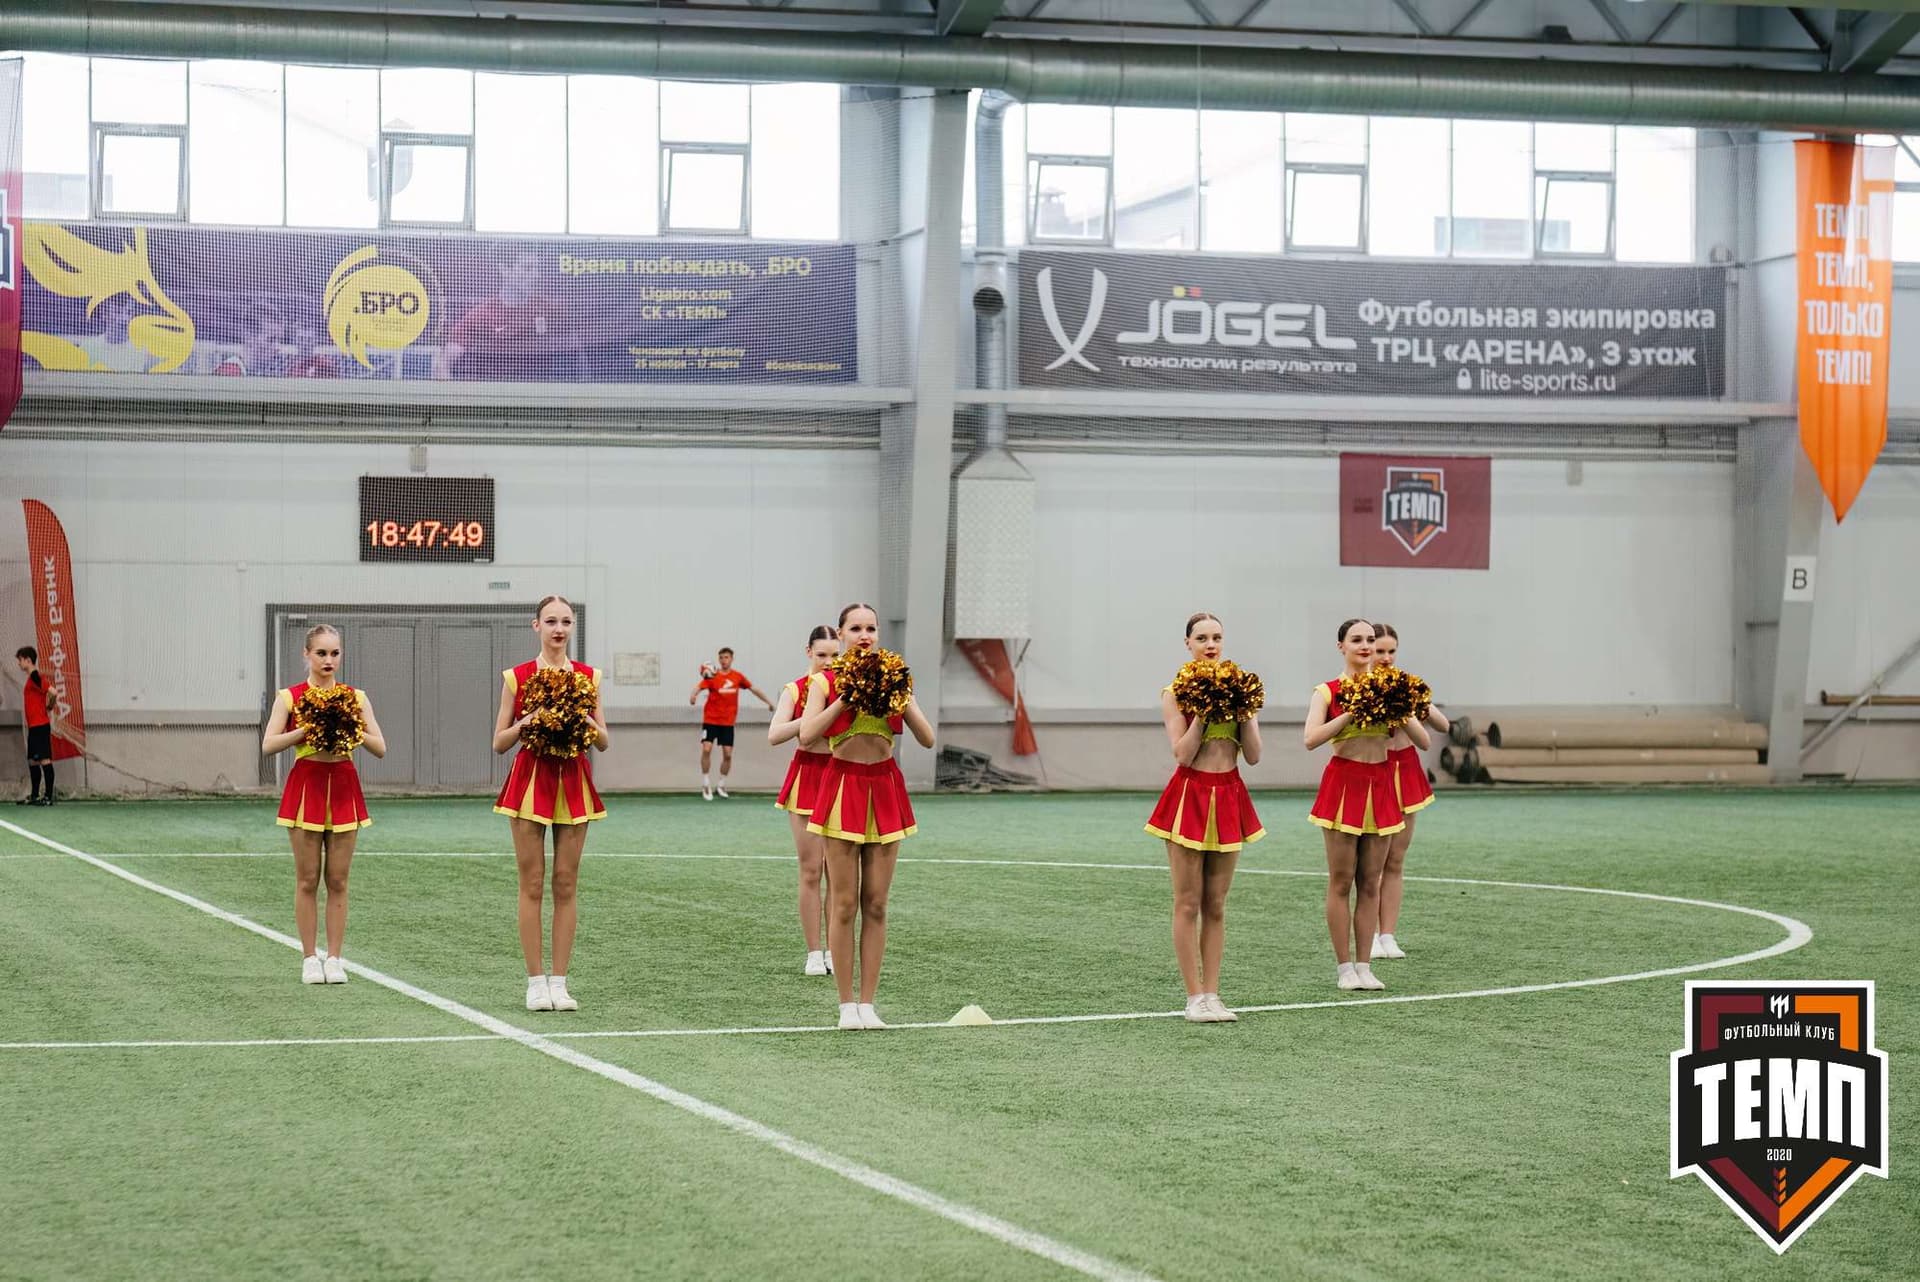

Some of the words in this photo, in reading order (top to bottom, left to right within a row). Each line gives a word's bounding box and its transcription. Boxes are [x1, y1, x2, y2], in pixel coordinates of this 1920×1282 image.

[560, 255, 625, 275] Время
[1358, 299, 1538, 332] Футбольная
[1545, 305, 1716, 335] экипировка
[1805, 300, 1885, 337] ТОЛЬКО
[1117, 355, 1237, 370] технологии
[1242, 358, 1357, 374] результата
[1371, 337, 1436, 368] ТРЦ
[1443, 339, 1594, 369] «АРЕНА»,
[1602, 341, 1621, 366] 3
[1627, 346, 1697, 367] этаж
[1816, 348, 1872, 385] ТЕМП!
[1480, 368, 1616, 396] lite-sports.ru
[1389, 491, 1442, 523] ТЕМП
[367, 520, 483, 548] 18:47:49
[44, 556, 63, 625] Банк
